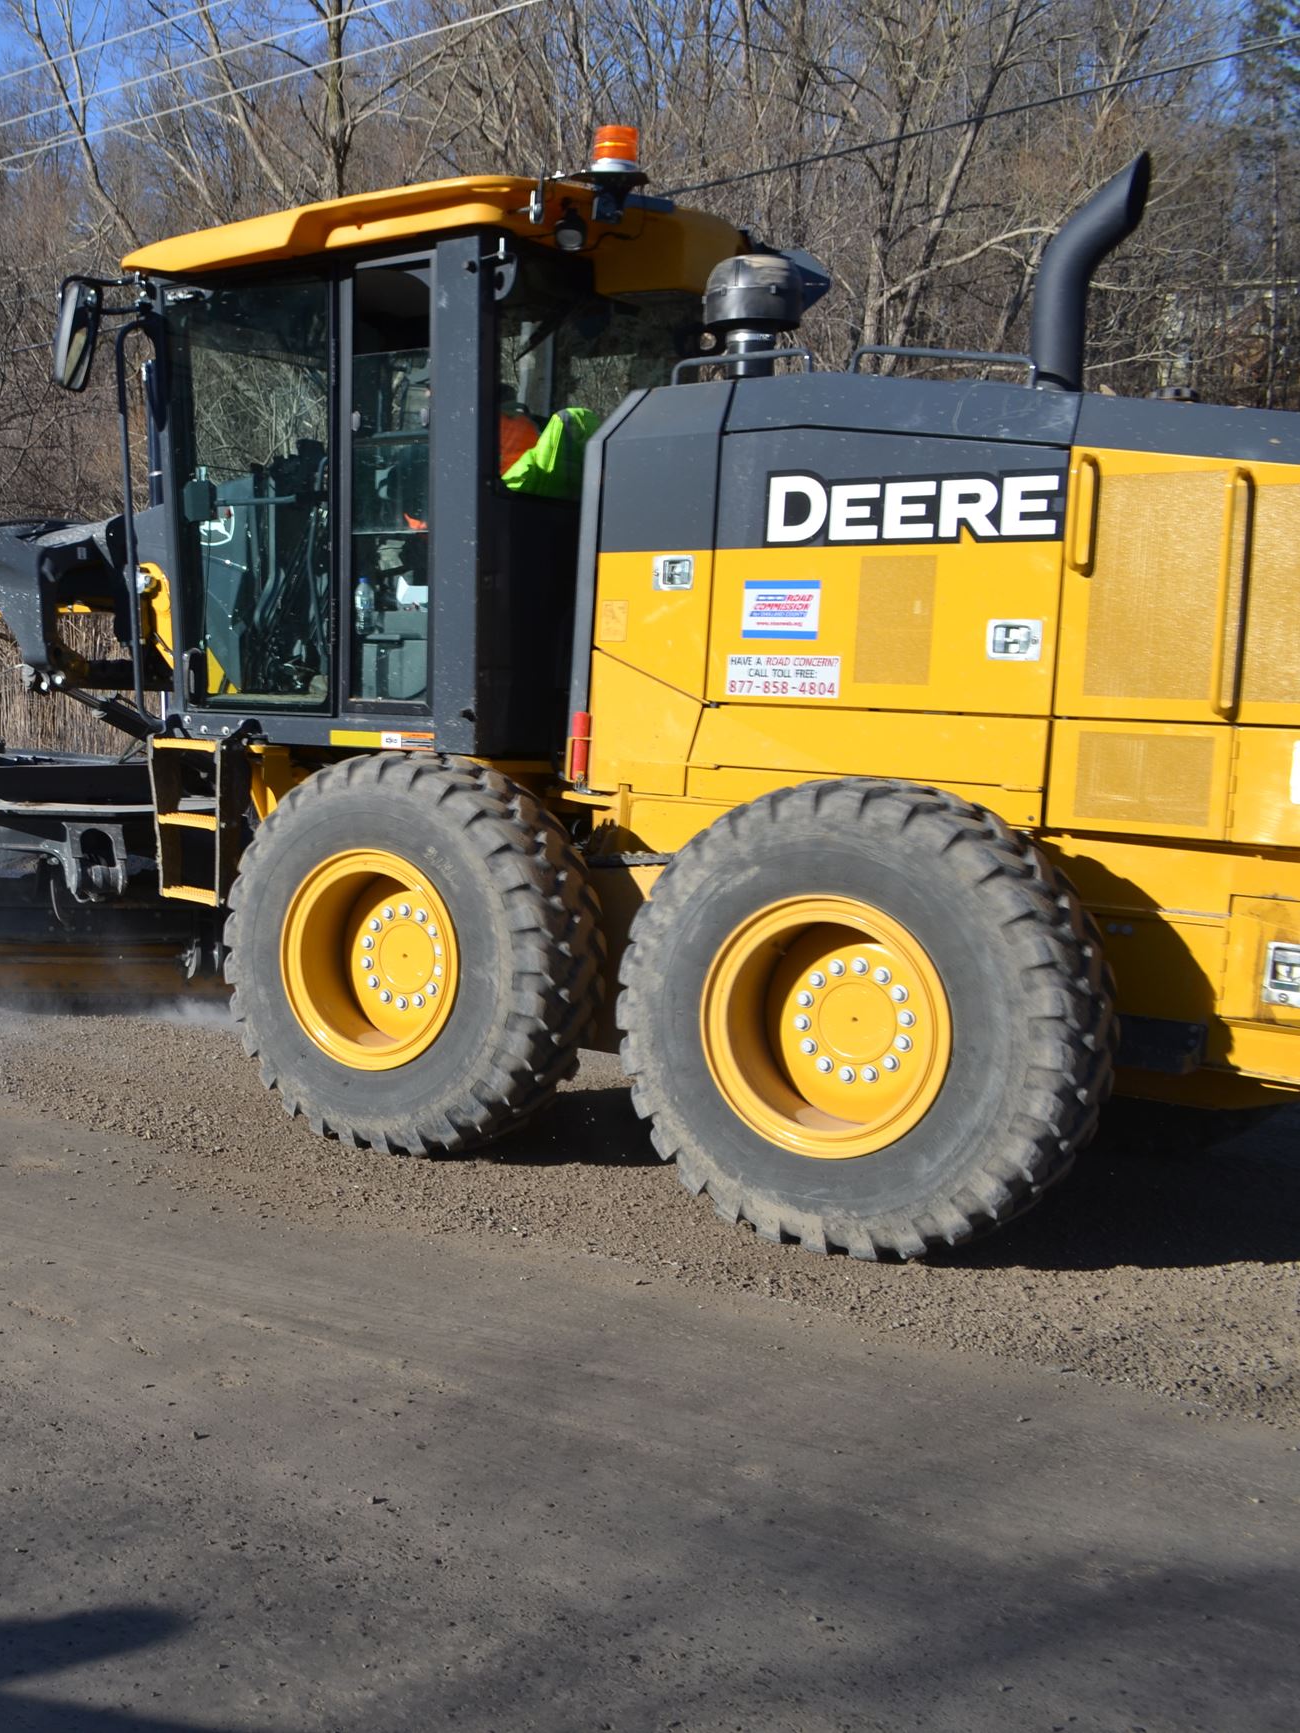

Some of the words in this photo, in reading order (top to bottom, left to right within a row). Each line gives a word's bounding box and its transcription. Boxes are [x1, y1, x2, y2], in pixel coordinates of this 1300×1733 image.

[766, 475, 1060, 543] DEERE
[786, 594, 813, 602] ROAD
[753, 603, 810, 611] COMMISSION
[730, 656, 753, 666] HAVE
[755, 657, 763, 666] A
[766, 656, 791, 667] ROAD
[793, 657, 840, 668] CONCERN?
[748, 667, 769, 678] CALL
[772, 668, 792, 679] TOLL
[795, 669, 818, 679] FREE:
[728, 680, 836, 695] 877-858-4804
